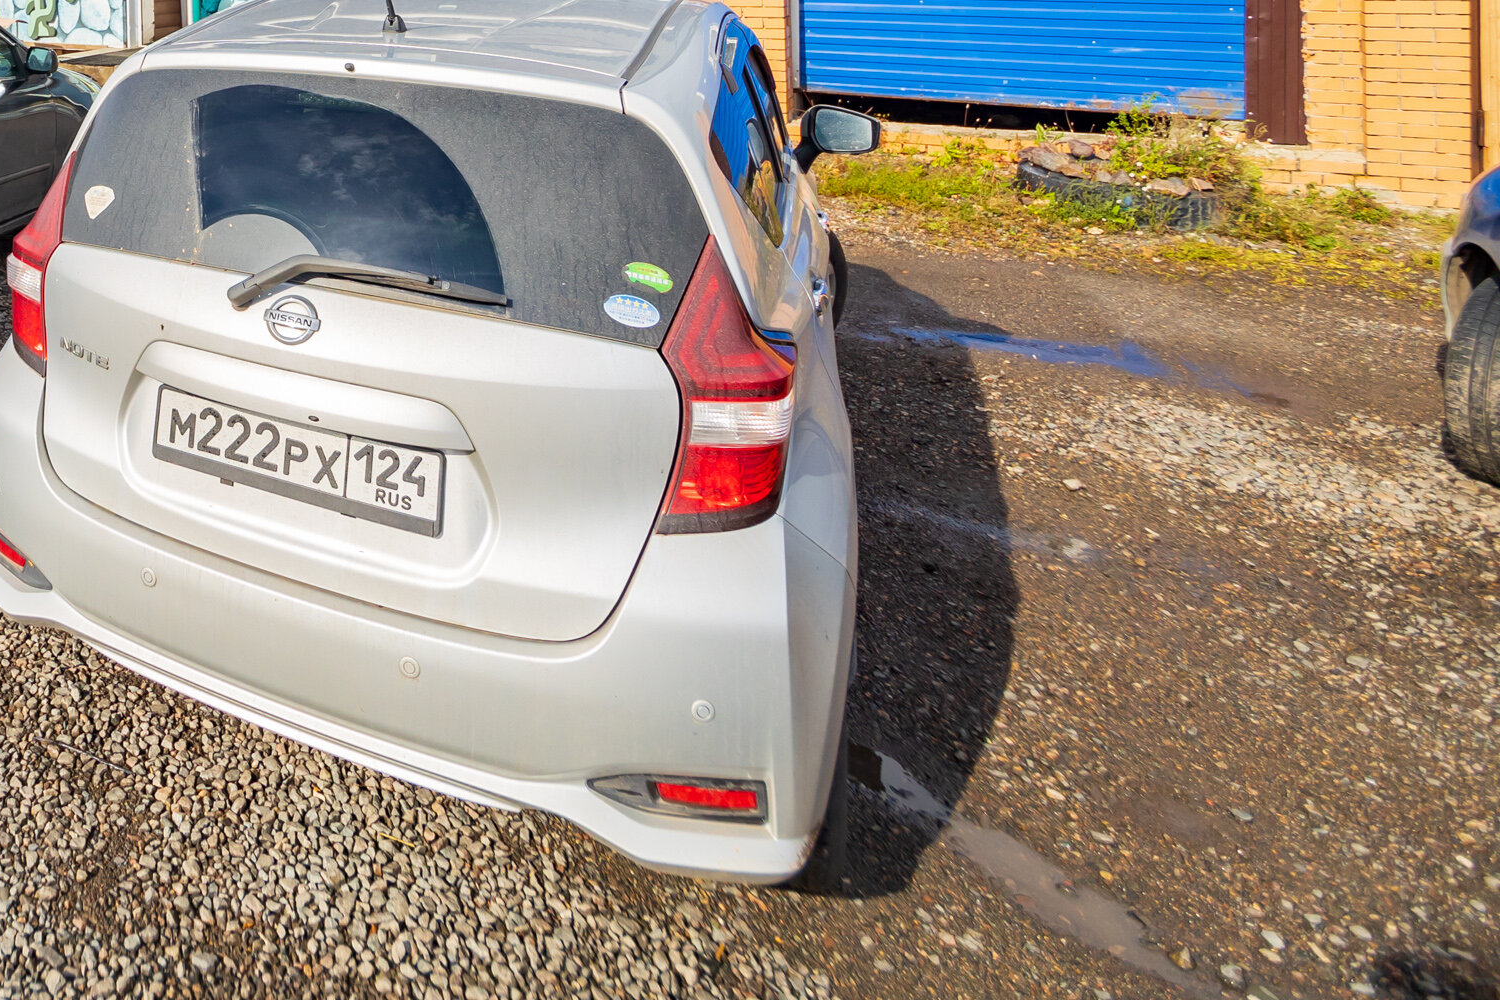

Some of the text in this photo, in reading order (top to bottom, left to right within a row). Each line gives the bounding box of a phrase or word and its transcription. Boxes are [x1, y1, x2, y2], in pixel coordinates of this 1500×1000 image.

[269, 311, 313, 329] NISSAN
[59, 335, 110, 371] NOTE
[353, 444, 426, 498] 124
[375, 489, 412, 511] RUS
